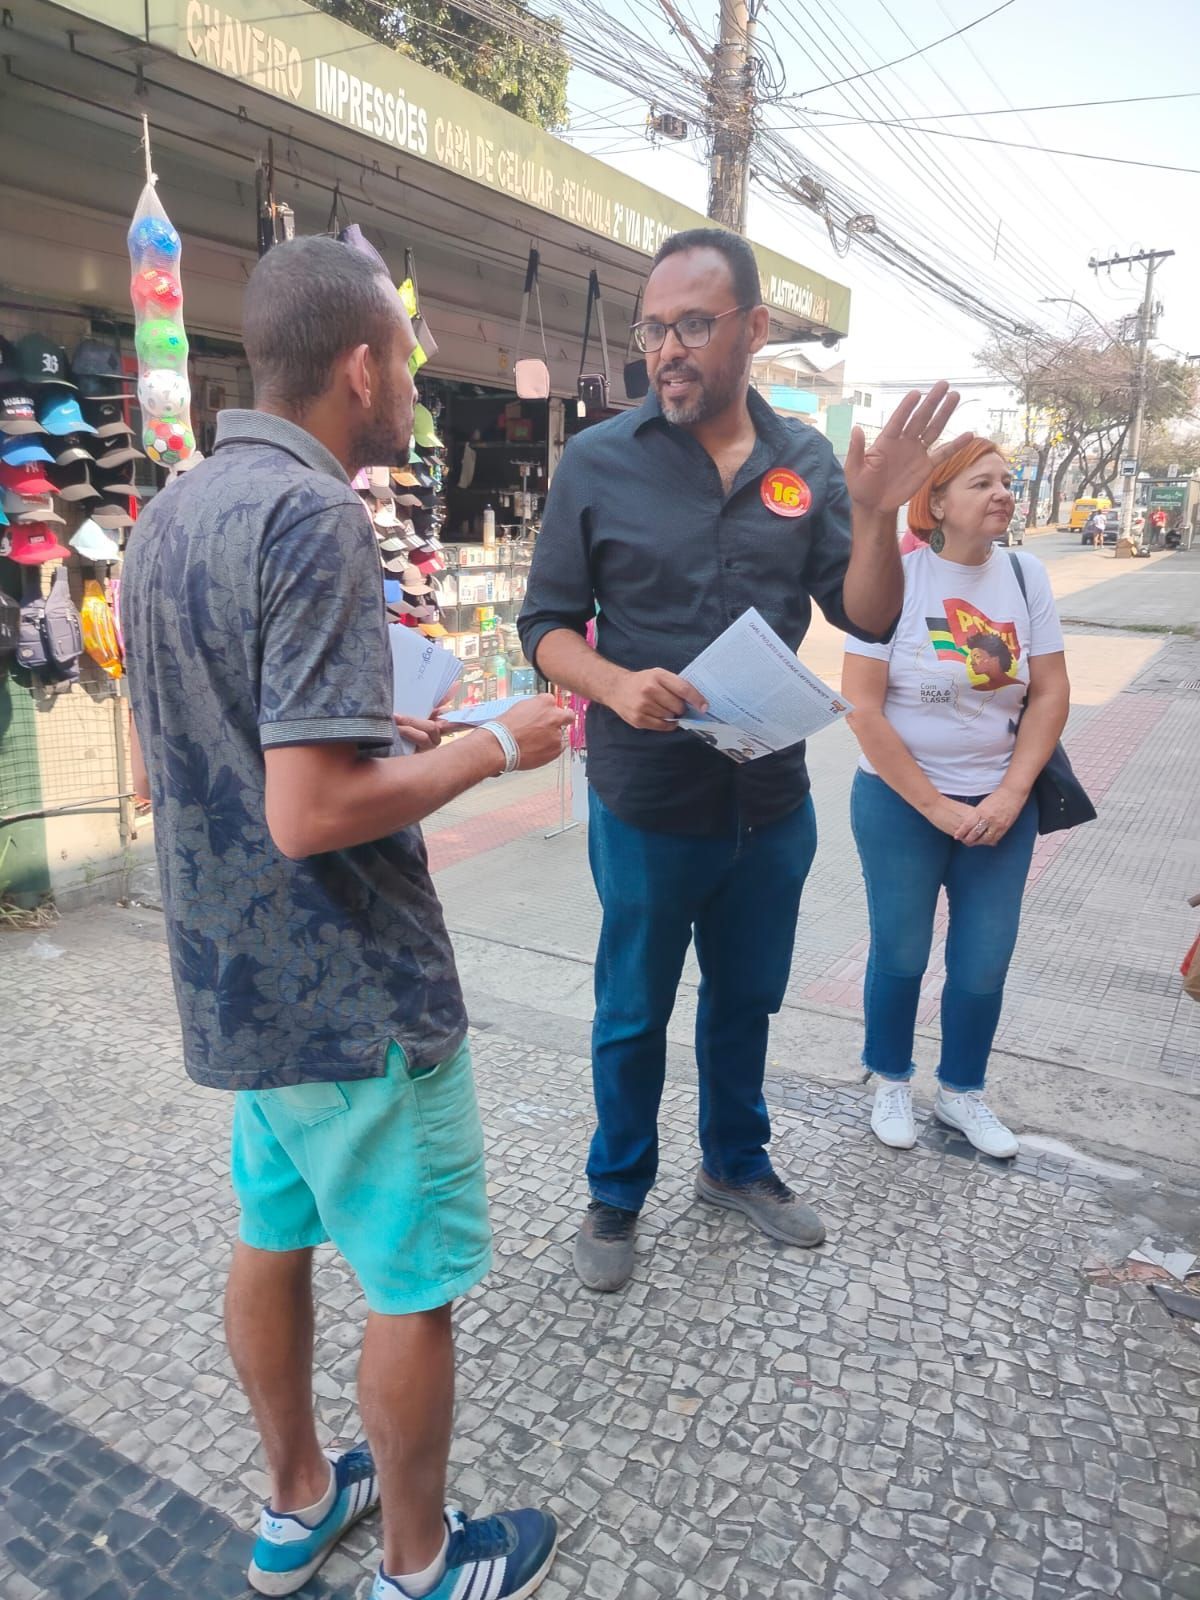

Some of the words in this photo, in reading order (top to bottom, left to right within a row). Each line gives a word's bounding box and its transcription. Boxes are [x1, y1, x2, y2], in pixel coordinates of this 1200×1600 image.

[186, 0, 302, 100] CHAVEIRO
[314, 57, 428, 156] IMPRESSÕES
[434, 117, 472, 174] CAPA
[476, 135, 494, 183] DE
[497, 150, 554, 210] CELULAR
[561, 177, 612, 236] PELÍCULA
[625, 207, 641, 249] VIA
[642, 215, 655, 254] DE
[771, 481, 801, 507] 16
